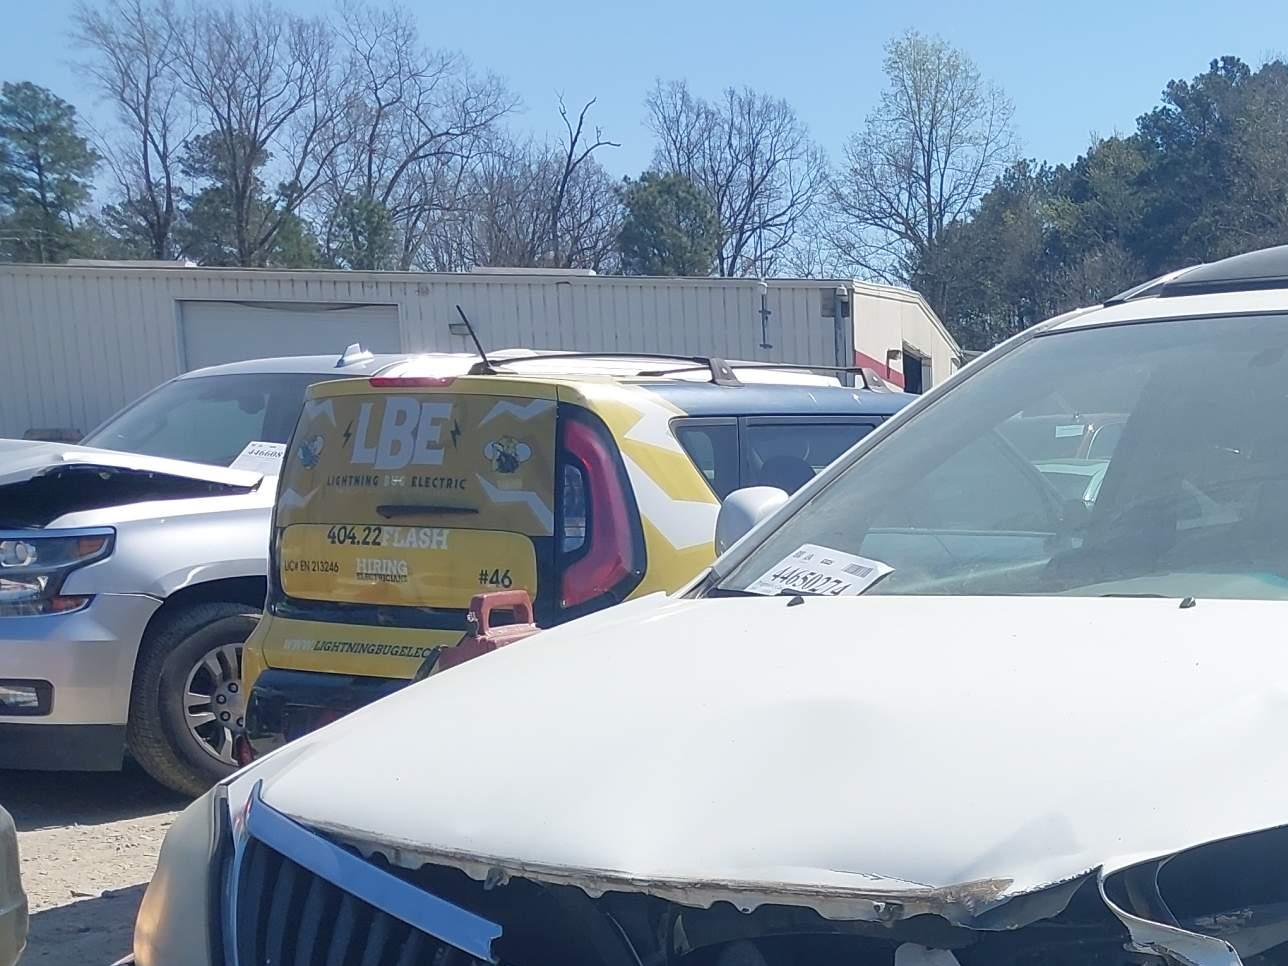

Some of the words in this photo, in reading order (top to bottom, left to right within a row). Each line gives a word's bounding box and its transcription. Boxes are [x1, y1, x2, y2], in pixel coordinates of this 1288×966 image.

[350, 396, 452, 470] LBE
[327, 475, 379, 487] LIGHTNING
[411, 476, 468, 490] ELECTRIC
[311, 560, 339, 573] 213246
[355, 558, 408, 575] HIRING
[478, 568, 513, 589] #46
[771, 566, 852, 595] 44650274
